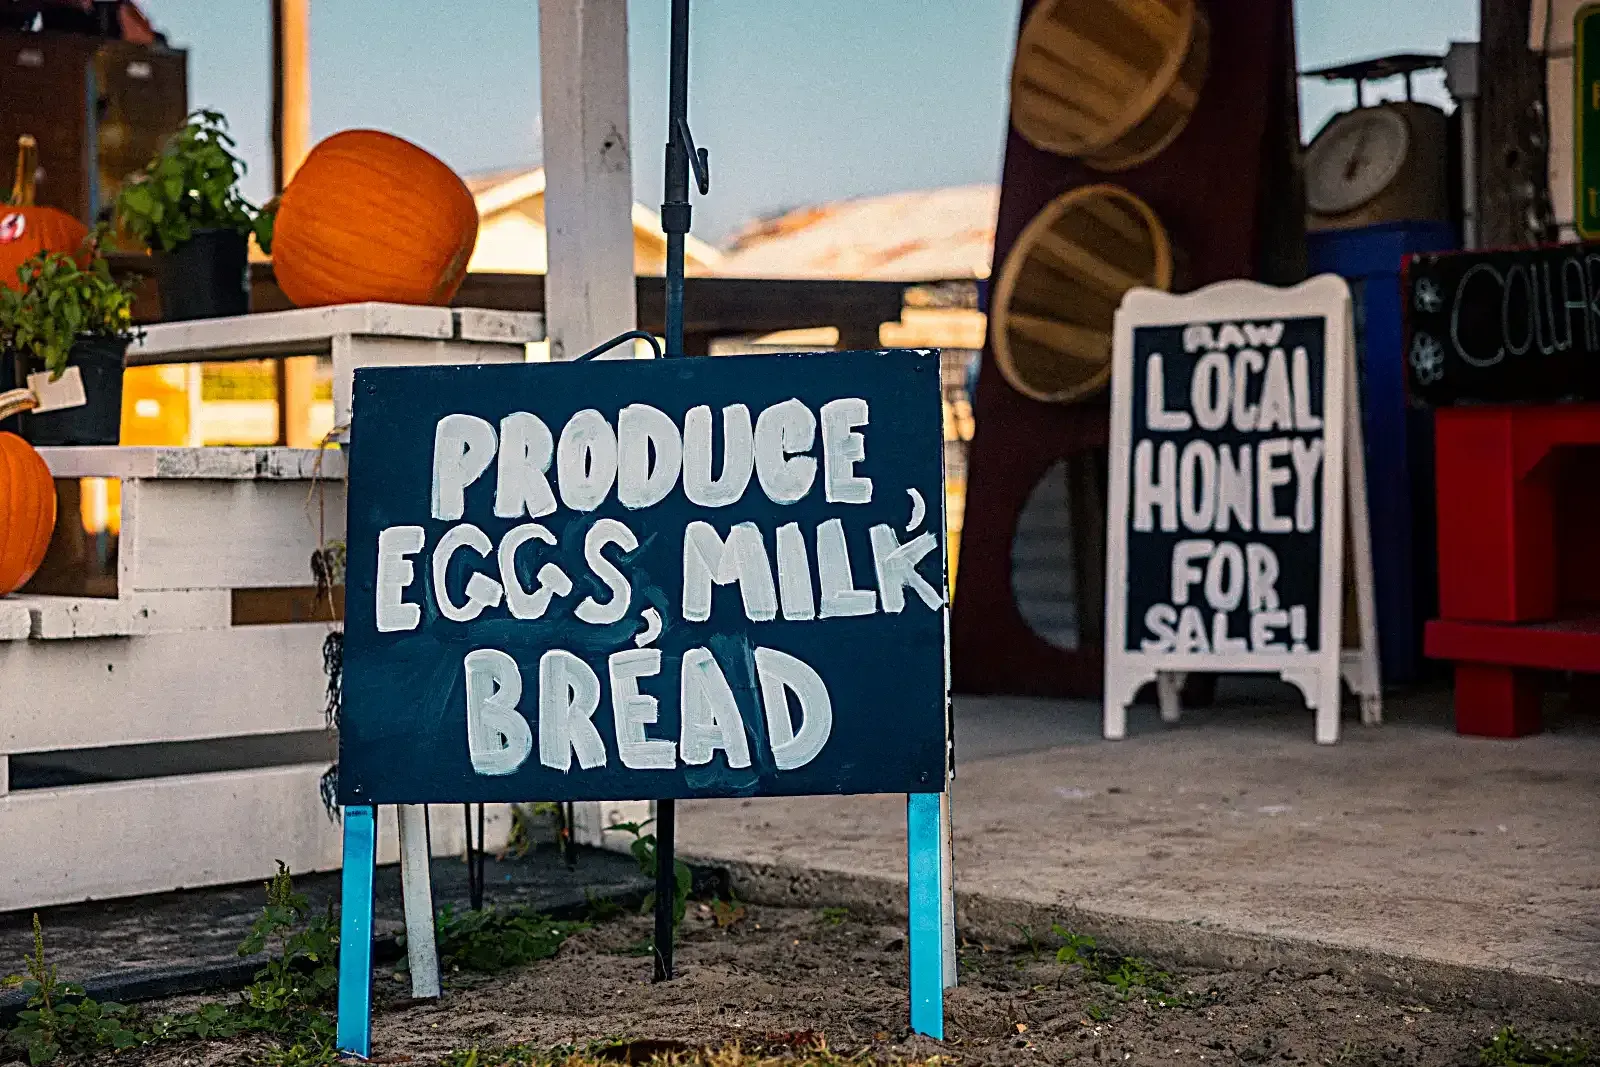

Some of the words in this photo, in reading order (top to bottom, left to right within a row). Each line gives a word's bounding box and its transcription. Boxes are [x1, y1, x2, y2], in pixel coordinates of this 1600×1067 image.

[1183, 322, 1284, 353] RAW
[1146, 346, 1323, 431] LOCAL
[1133, 437, 1323, 533] HONEY
[376, 518, 664, 647] EGGS,
[1171, 539, 1281, 613] FOR
[1139, 603, 1310, 653] SALE!
[464, 647, 833, 776] BREAD
